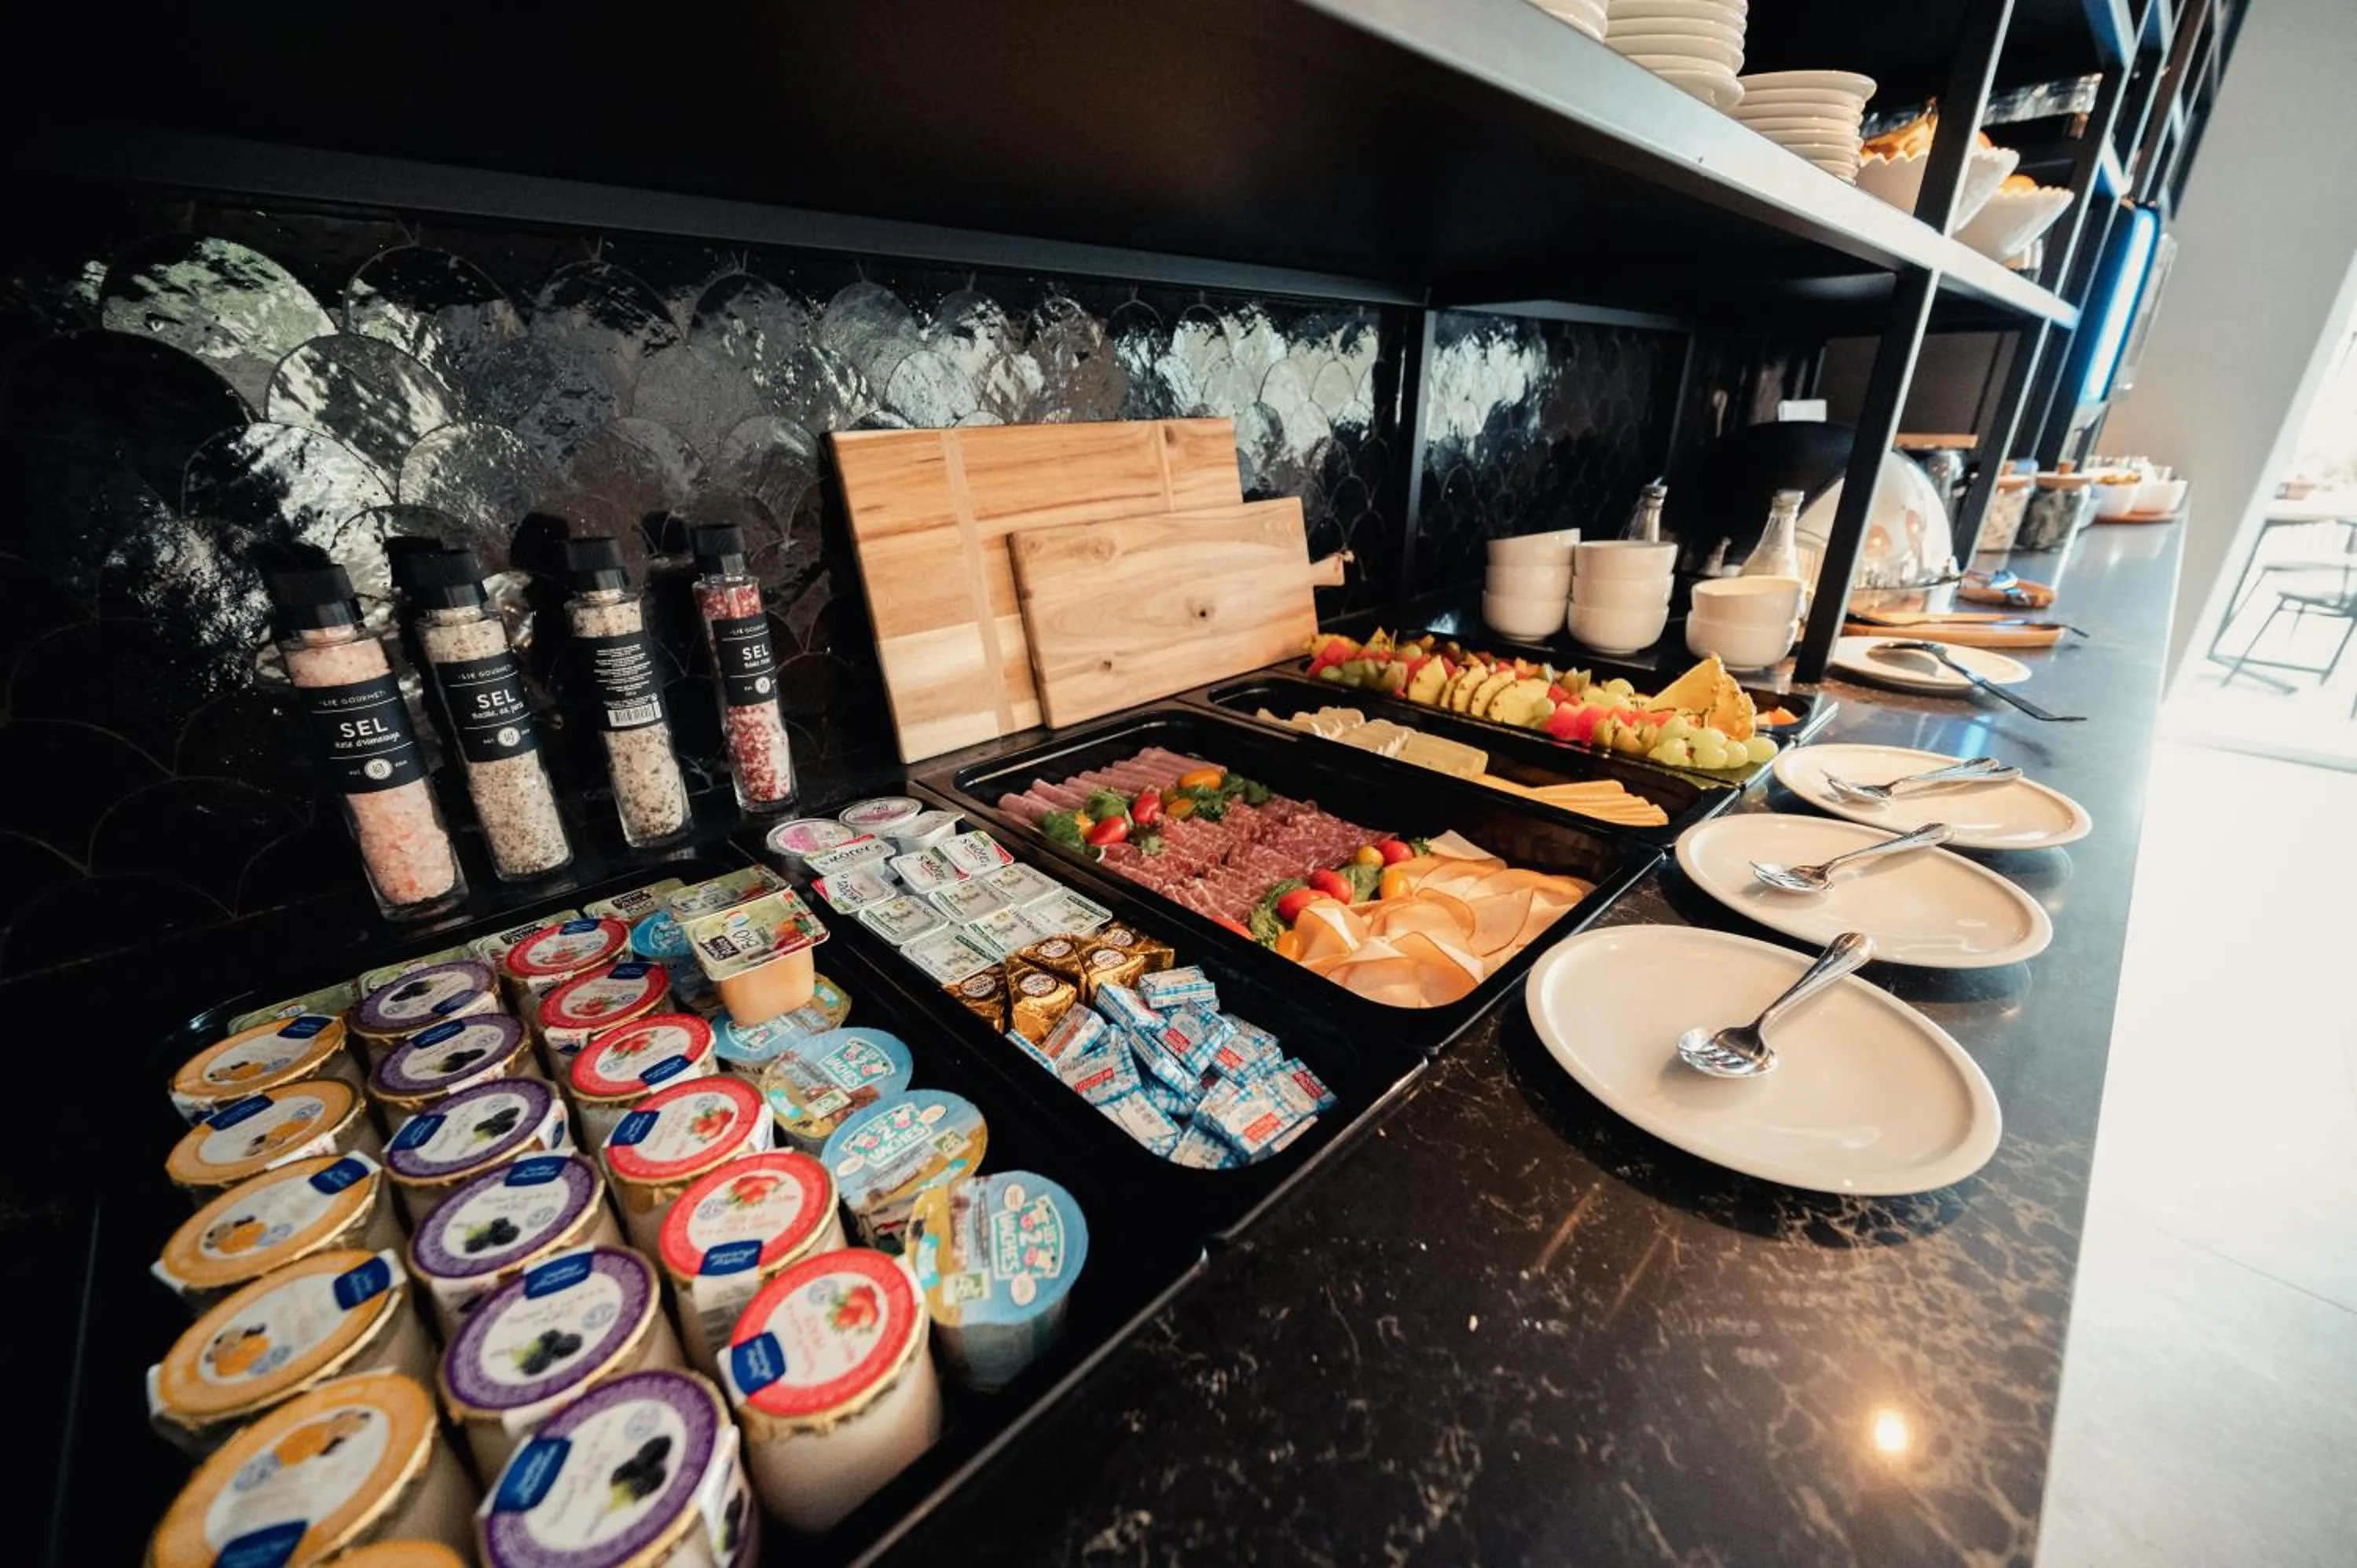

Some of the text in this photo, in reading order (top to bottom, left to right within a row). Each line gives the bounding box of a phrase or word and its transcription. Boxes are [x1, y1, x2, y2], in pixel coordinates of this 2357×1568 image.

[742, 643, 769, 661] SEL
[476, 688, 516, 709] SEL
[339, 717, 389, 738] SEL
[1018, 1229, 1043, 1247] 2
